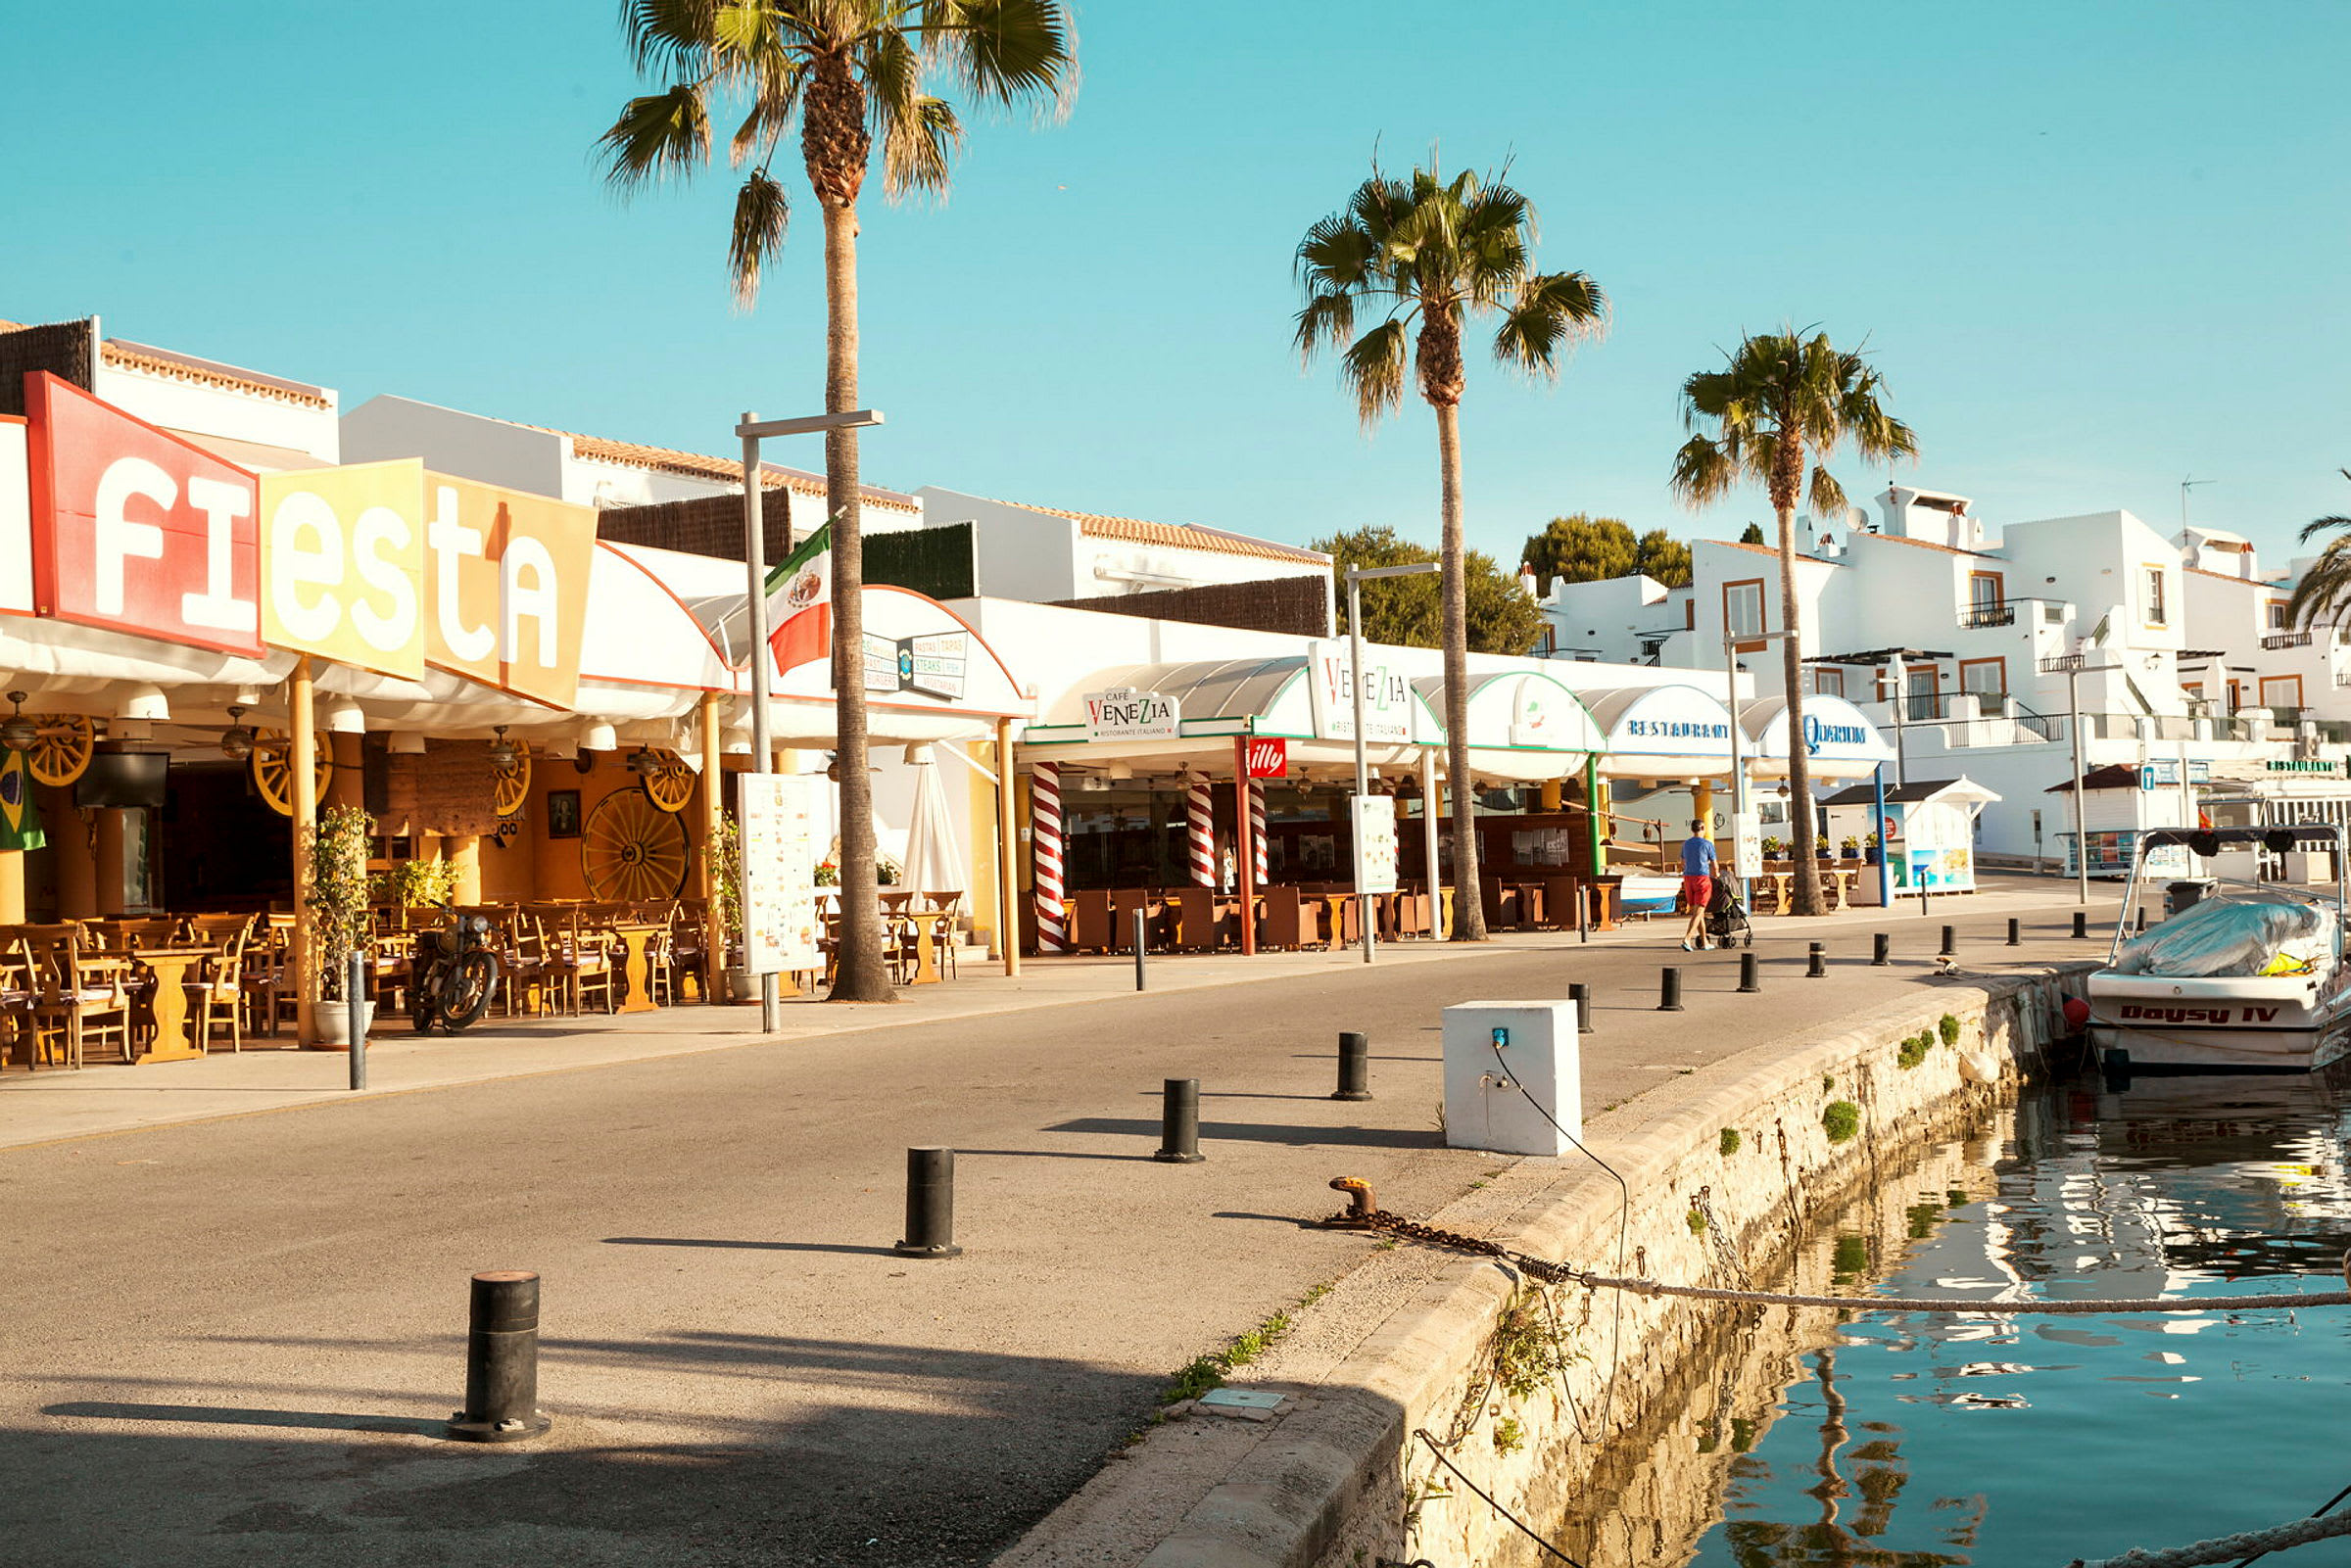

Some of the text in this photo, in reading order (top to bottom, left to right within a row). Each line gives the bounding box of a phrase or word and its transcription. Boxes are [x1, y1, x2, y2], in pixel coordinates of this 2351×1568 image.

[916, 658, 941, 672] STEAKS
[1324, 657, 1406, 711] VEEZIA
[1106, 689, 1129, 701] CAFÉ
[1088, 698, 1170, 726] VENEZIA
[1100, 727, 1166, 737] RISTORANTE ITALIANO
[1627, 720, 1728, 739] RESTAURANT
[1251, 743, 1283, 774] illy
[2242, 1007, 2280, 1022] IV
